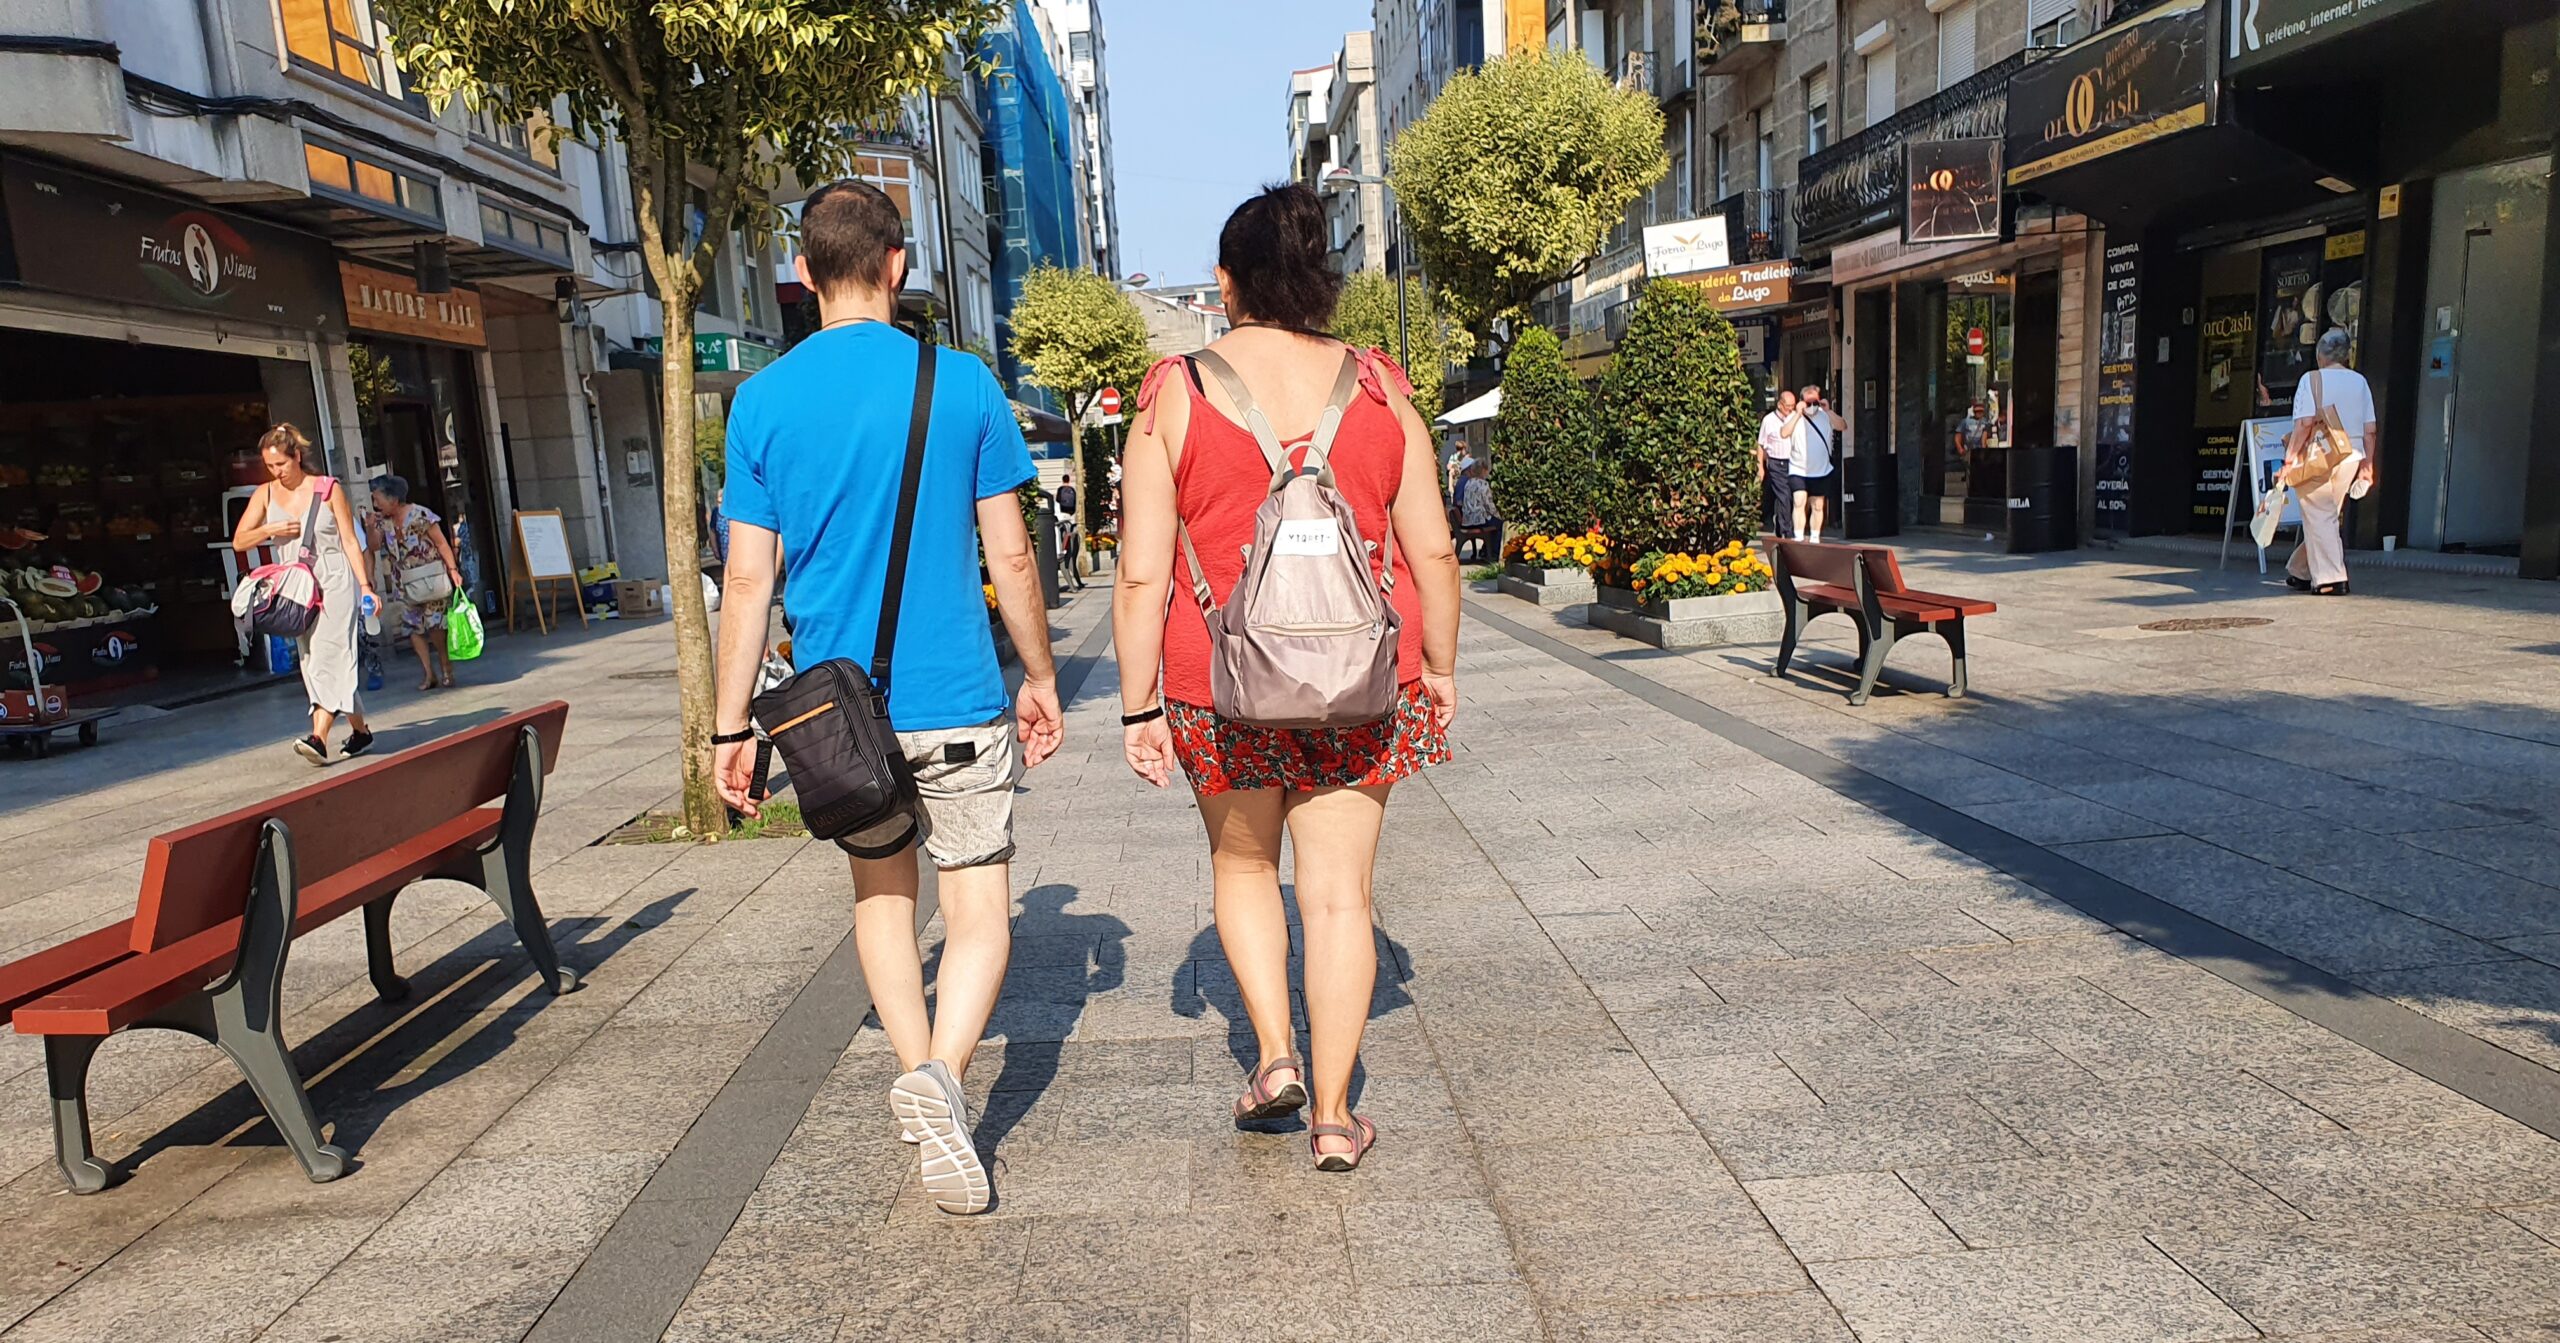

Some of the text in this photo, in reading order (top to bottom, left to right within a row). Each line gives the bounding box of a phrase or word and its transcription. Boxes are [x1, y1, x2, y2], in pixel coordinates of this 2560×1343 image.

[1652, 245, 1686, 258] Forno
[1696, 240, 1724, 251] Lugo
[2106, 242, 2139, 259] COMPRA
[140, 236, 257, 281] Frutas Nieves
[2109, 260, 2135, 274] VENTA
[2107, 277, 2136, 291] DE ORO
[1732, 285, 1770, 302] Lugo
[360, 284, 475, 328] NATURE NAIL
[2096, 478, 2129, 490] JOYERÍA
[2097, 500, 2107, 509] AL
